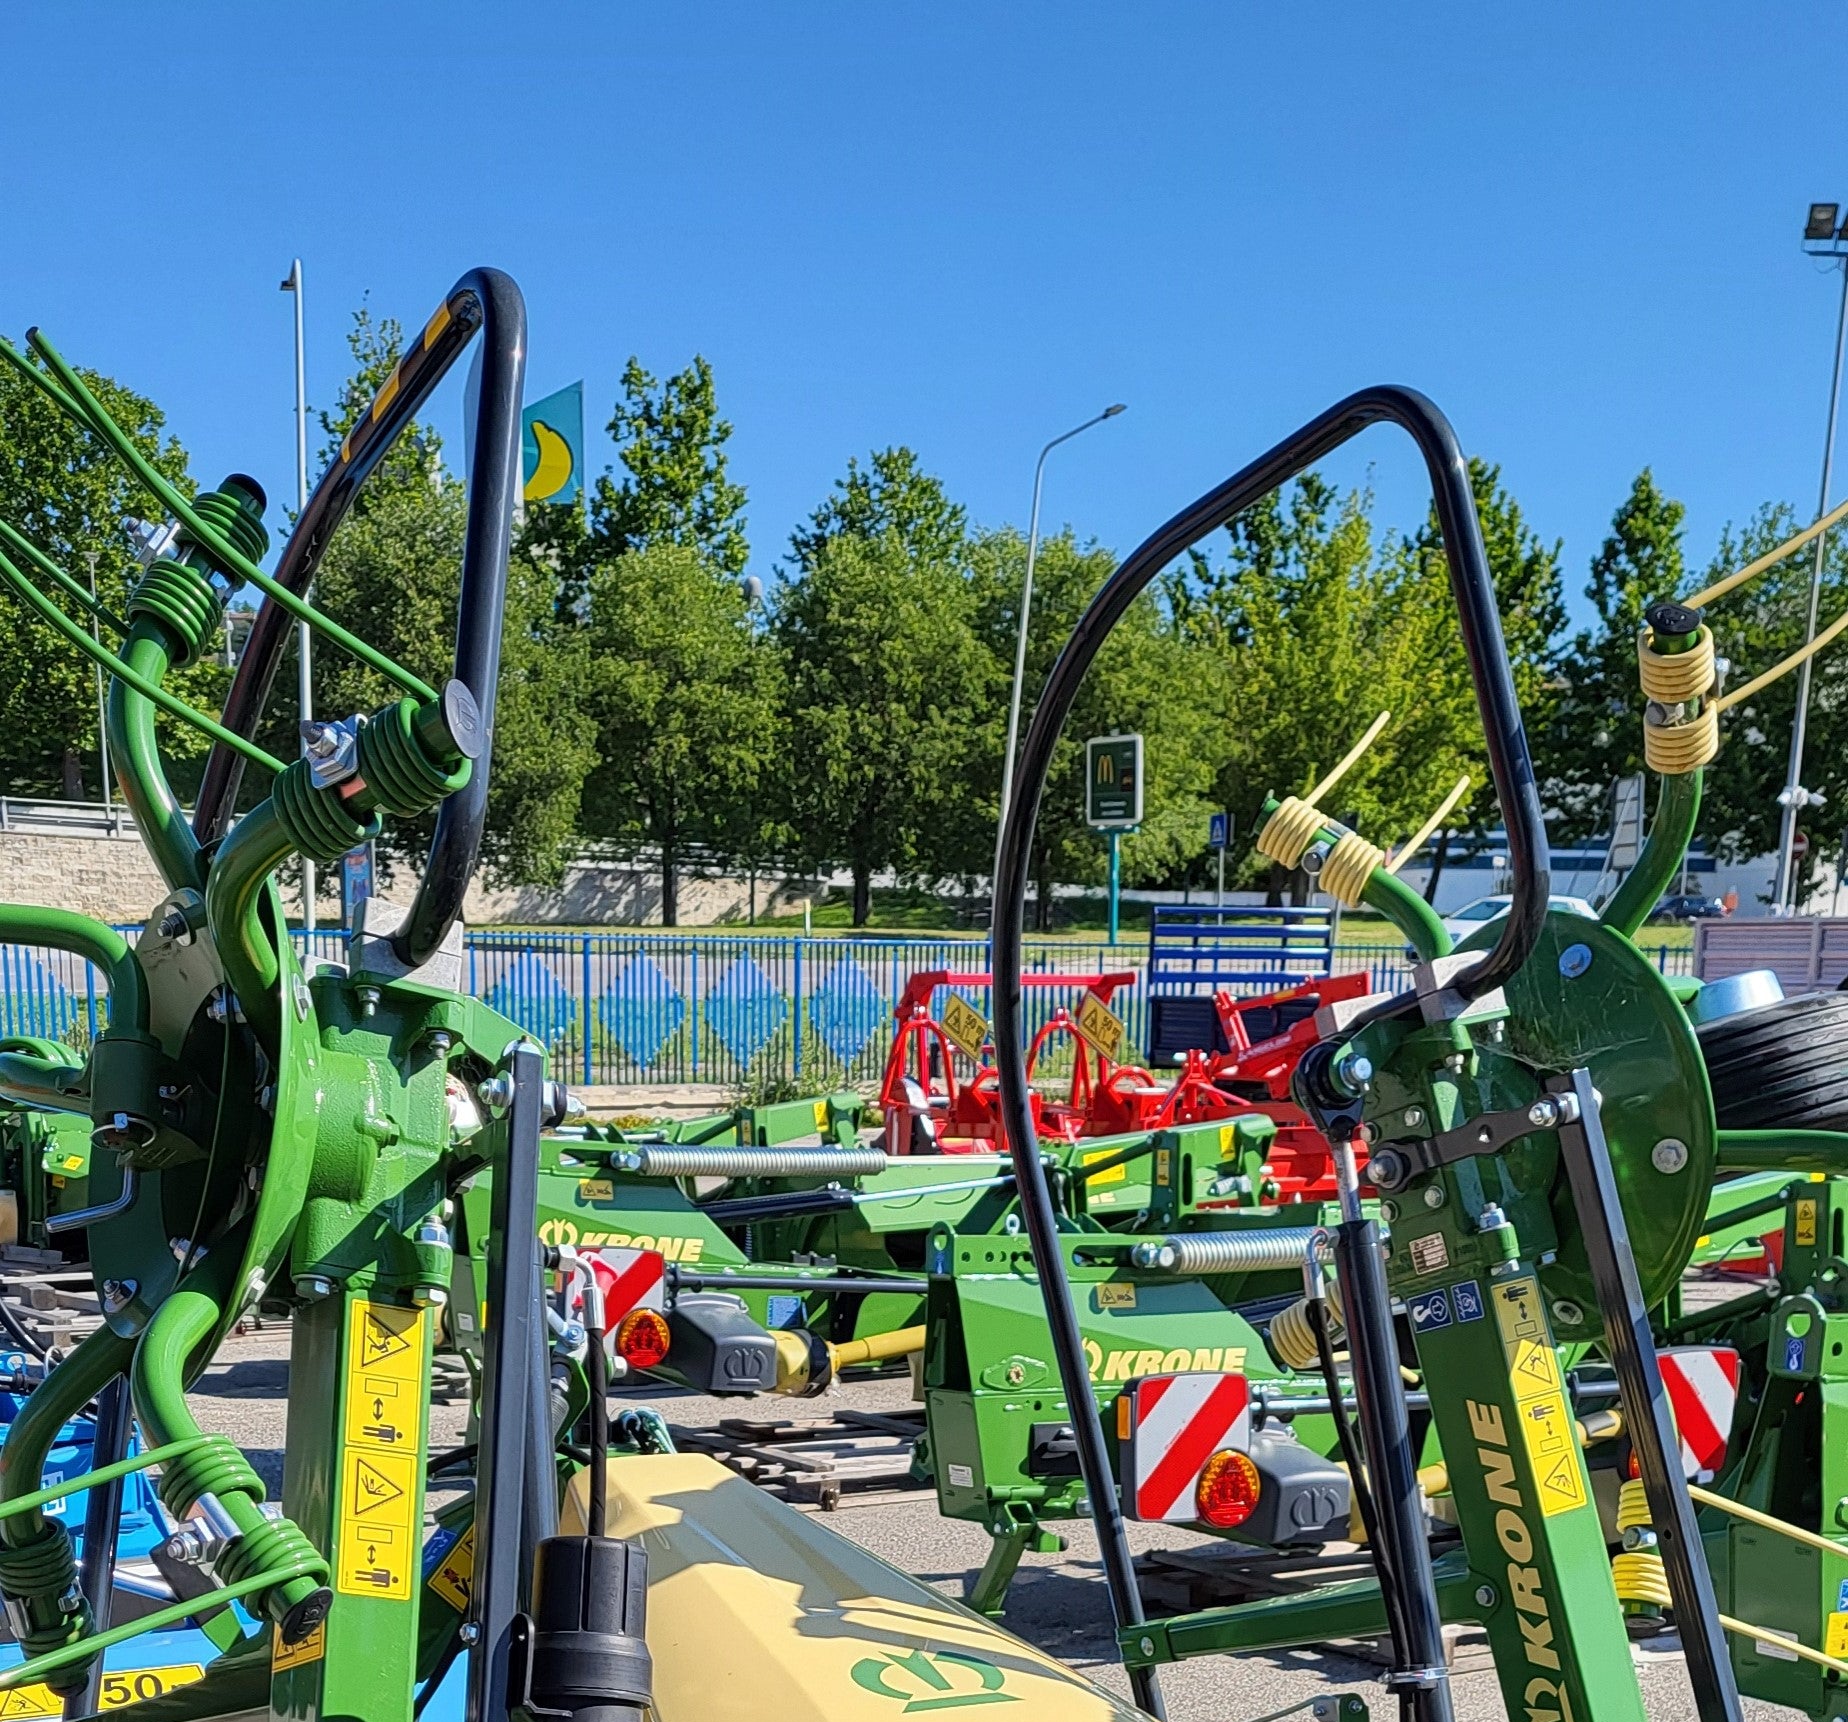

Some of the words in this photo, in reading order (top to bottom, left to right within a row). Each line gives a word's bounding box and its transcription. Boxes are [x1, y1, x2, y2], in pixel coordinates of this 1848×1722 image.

[1103, 1347, 1247, 1381] KRONE
[1466, 1400, 1561, 1671] KRONE
[103, 1673, 163, 1705] 50
